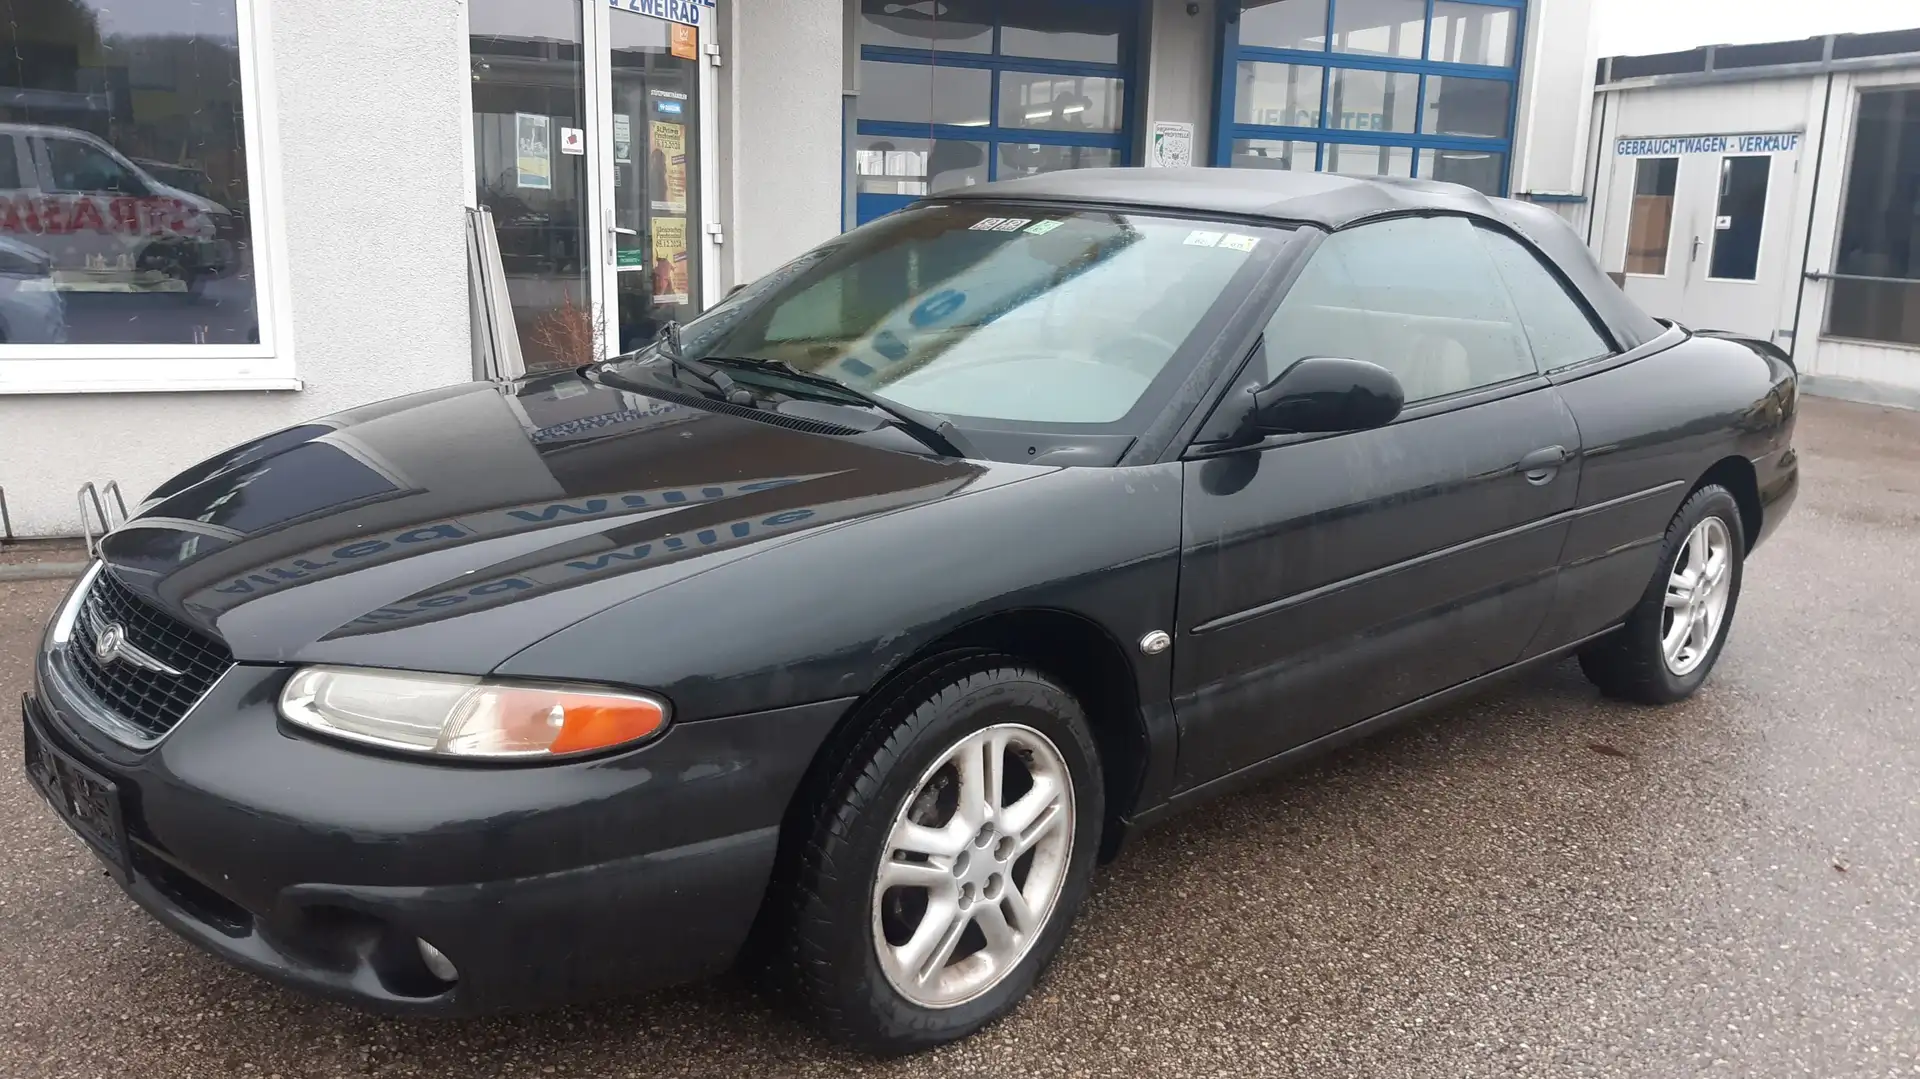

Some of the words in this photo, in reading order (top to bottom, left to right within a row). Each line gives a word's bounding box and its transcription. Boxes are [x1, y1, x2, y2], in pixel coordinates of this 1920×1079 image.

[629, 0, 699, 24] ZWEIRAD
[1617, 137, 1727, 155] GEBRAUCHTWAGEN
[1738, 135, 1799, 152] VERKAUF
